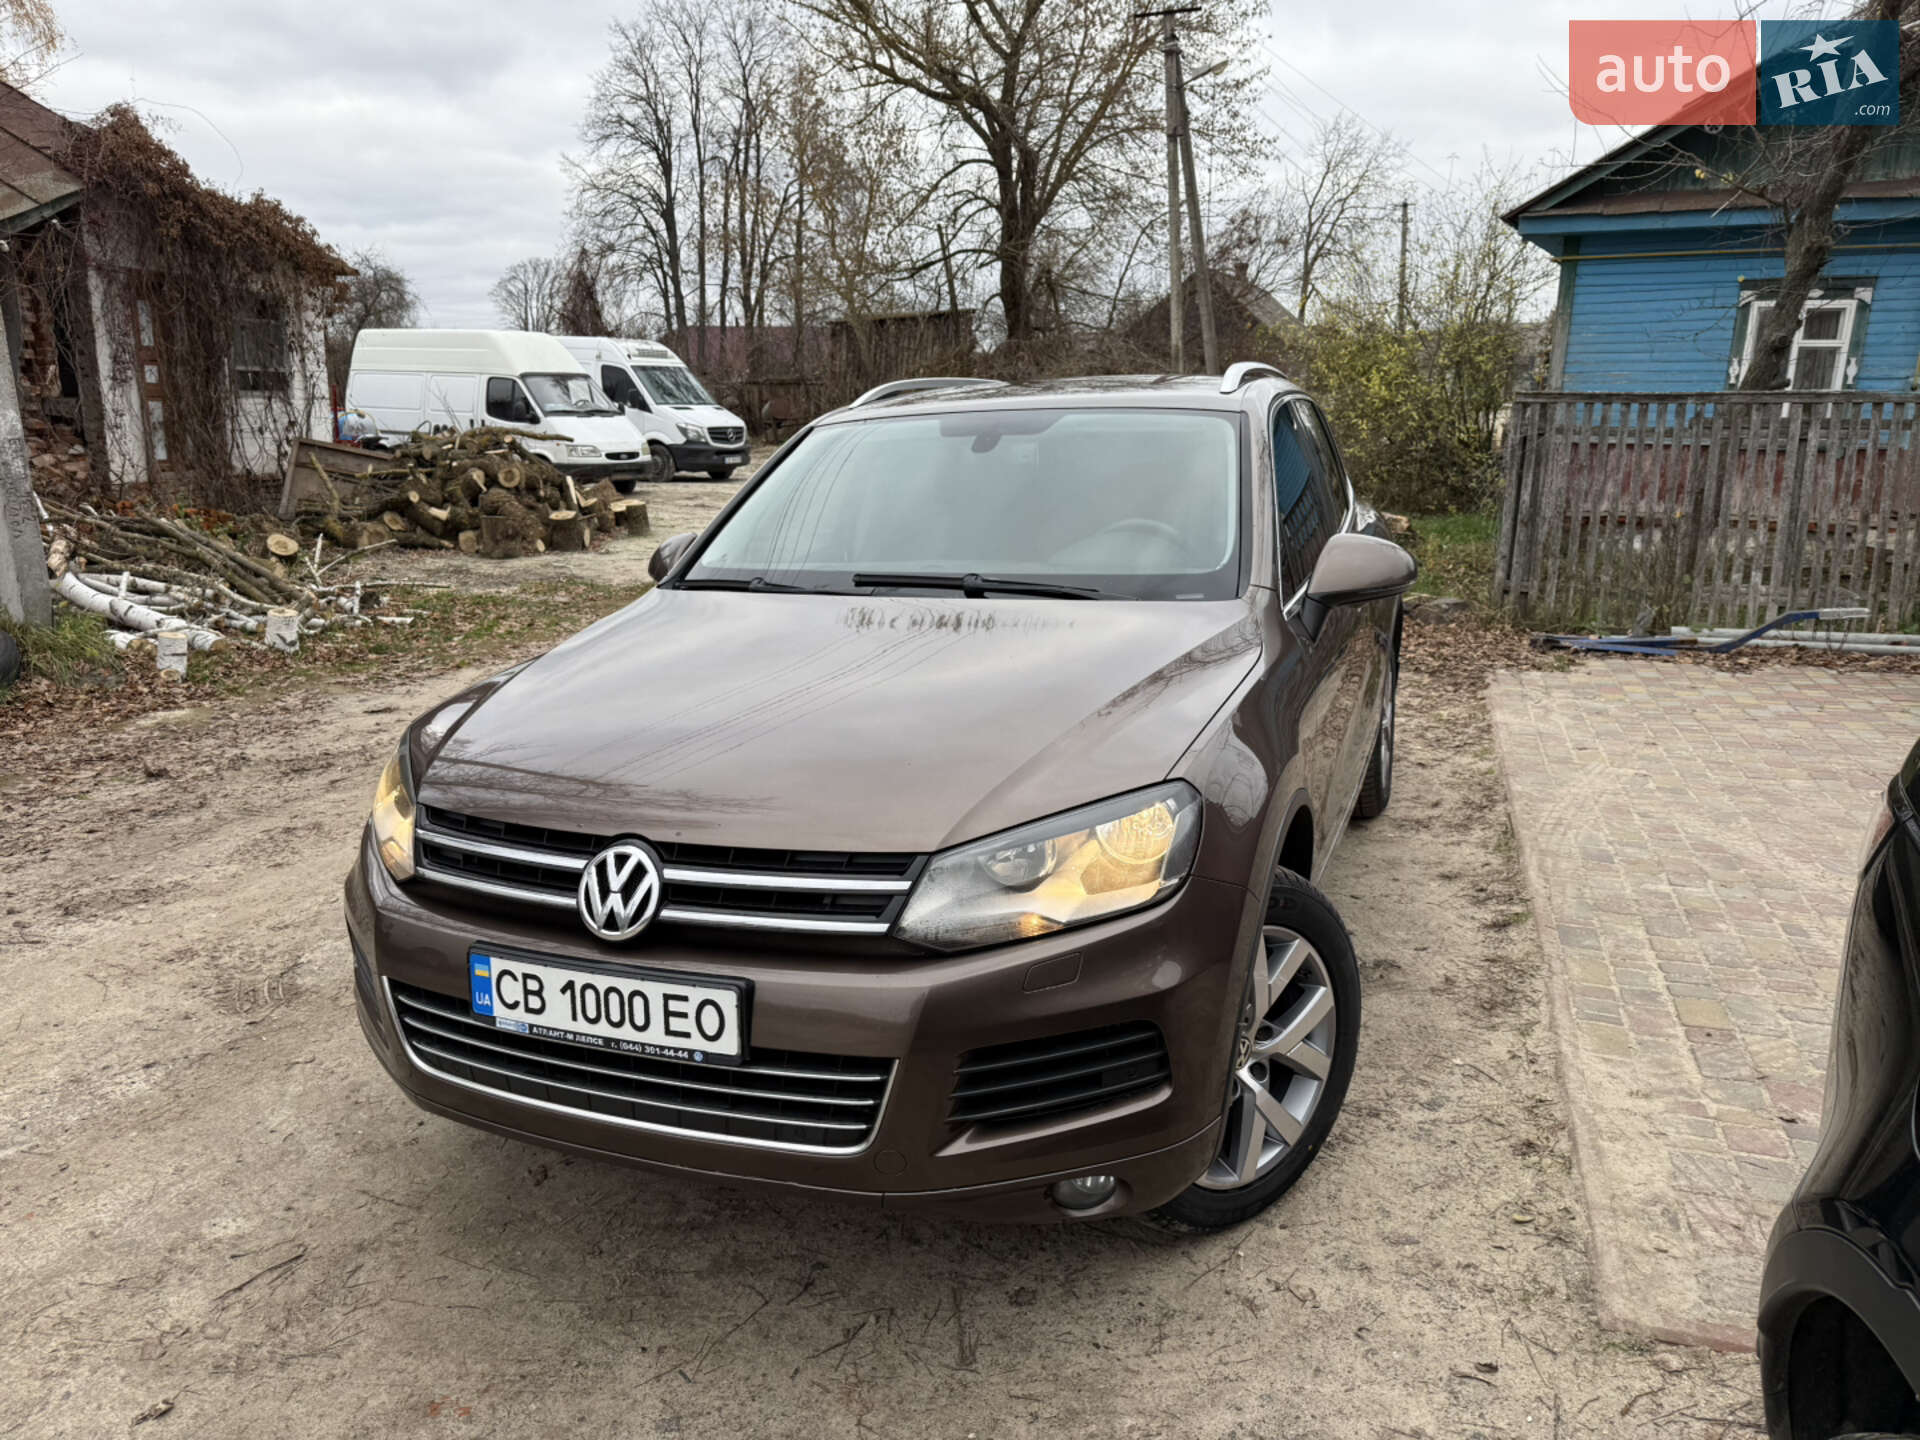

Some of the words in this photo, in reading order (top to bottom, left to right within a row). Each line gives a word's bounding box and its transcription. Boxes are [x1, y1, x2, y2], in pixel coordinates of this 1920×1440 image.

[475, 991, 491, 1007] UA
[495, 968, 546, 1015] CB
[560, 979, 650, 1032] 1000
[662, 992, 726, 1042] EO
